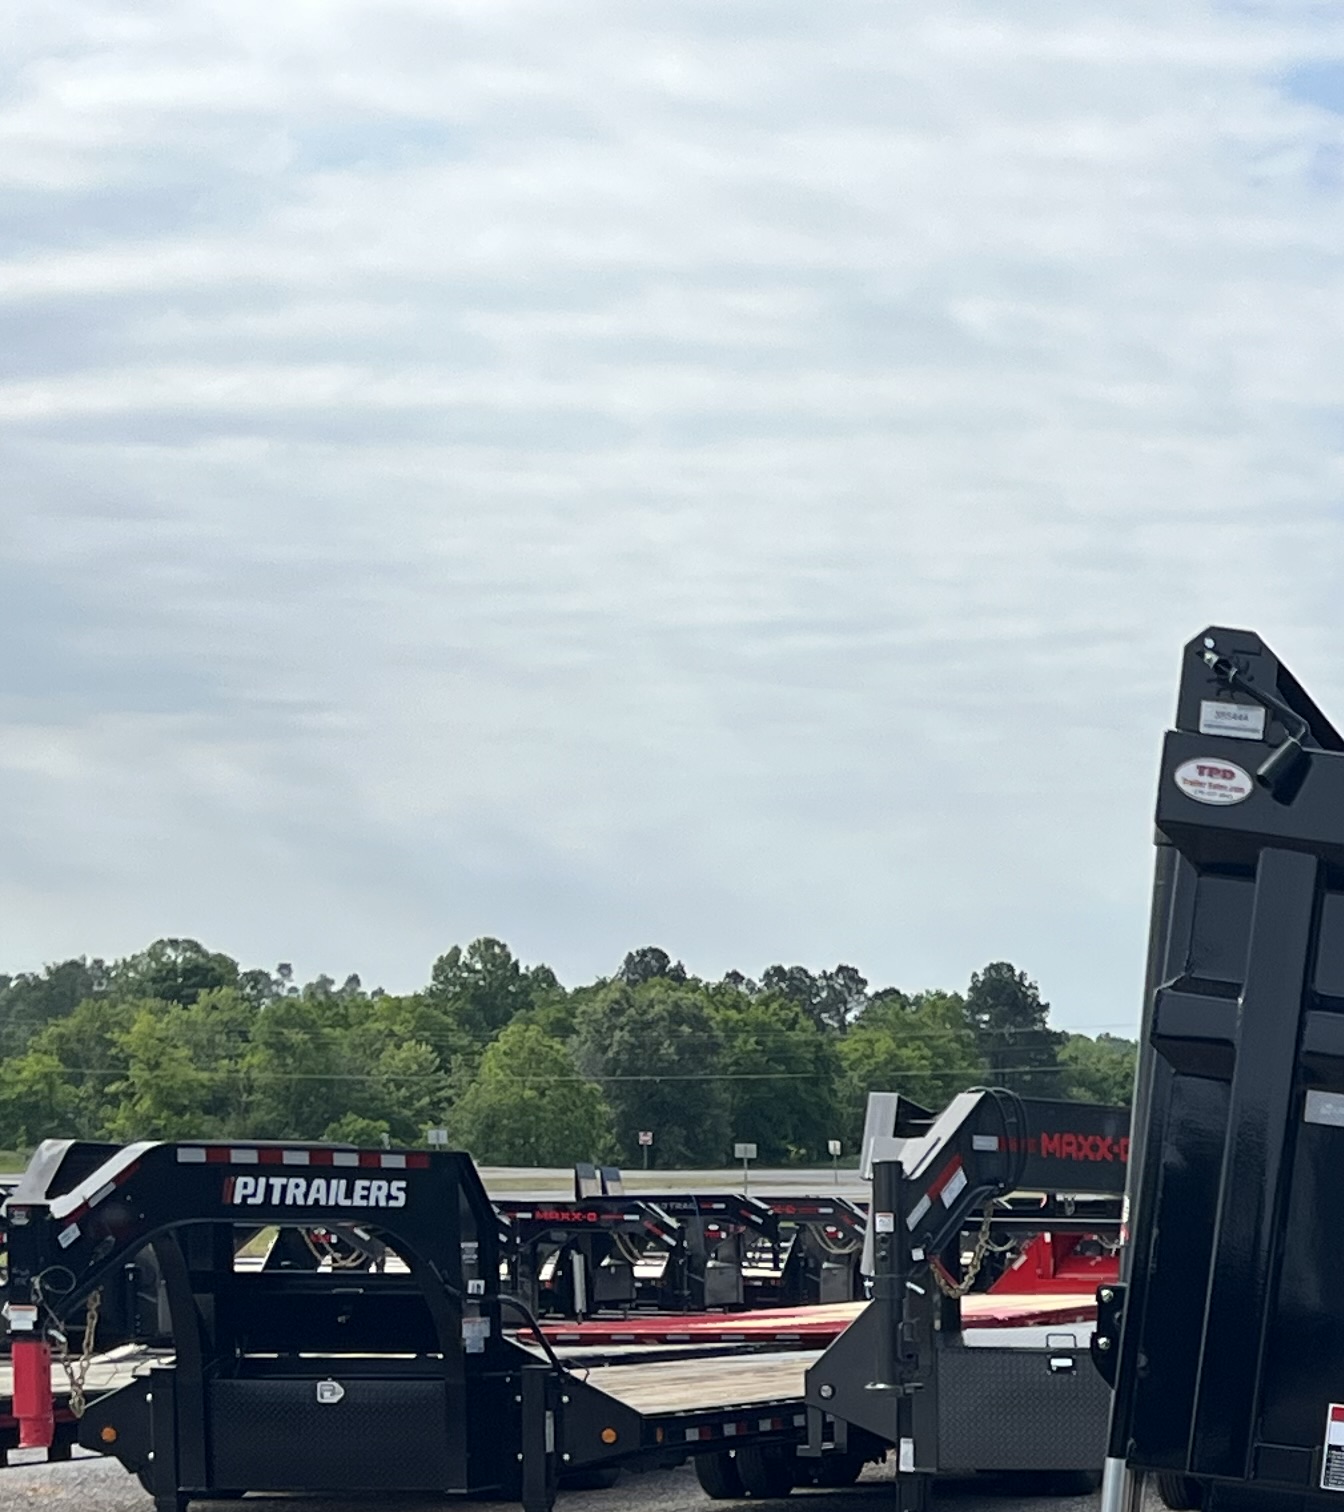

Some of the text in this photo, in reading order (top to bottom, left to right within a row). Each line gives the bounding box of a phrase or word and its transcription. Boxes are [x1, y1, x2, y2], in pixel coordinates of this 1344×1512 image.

[1196, 764, 1237, 781] TPD
[232, 1176, 408, 1207] PJ TRAILERS
